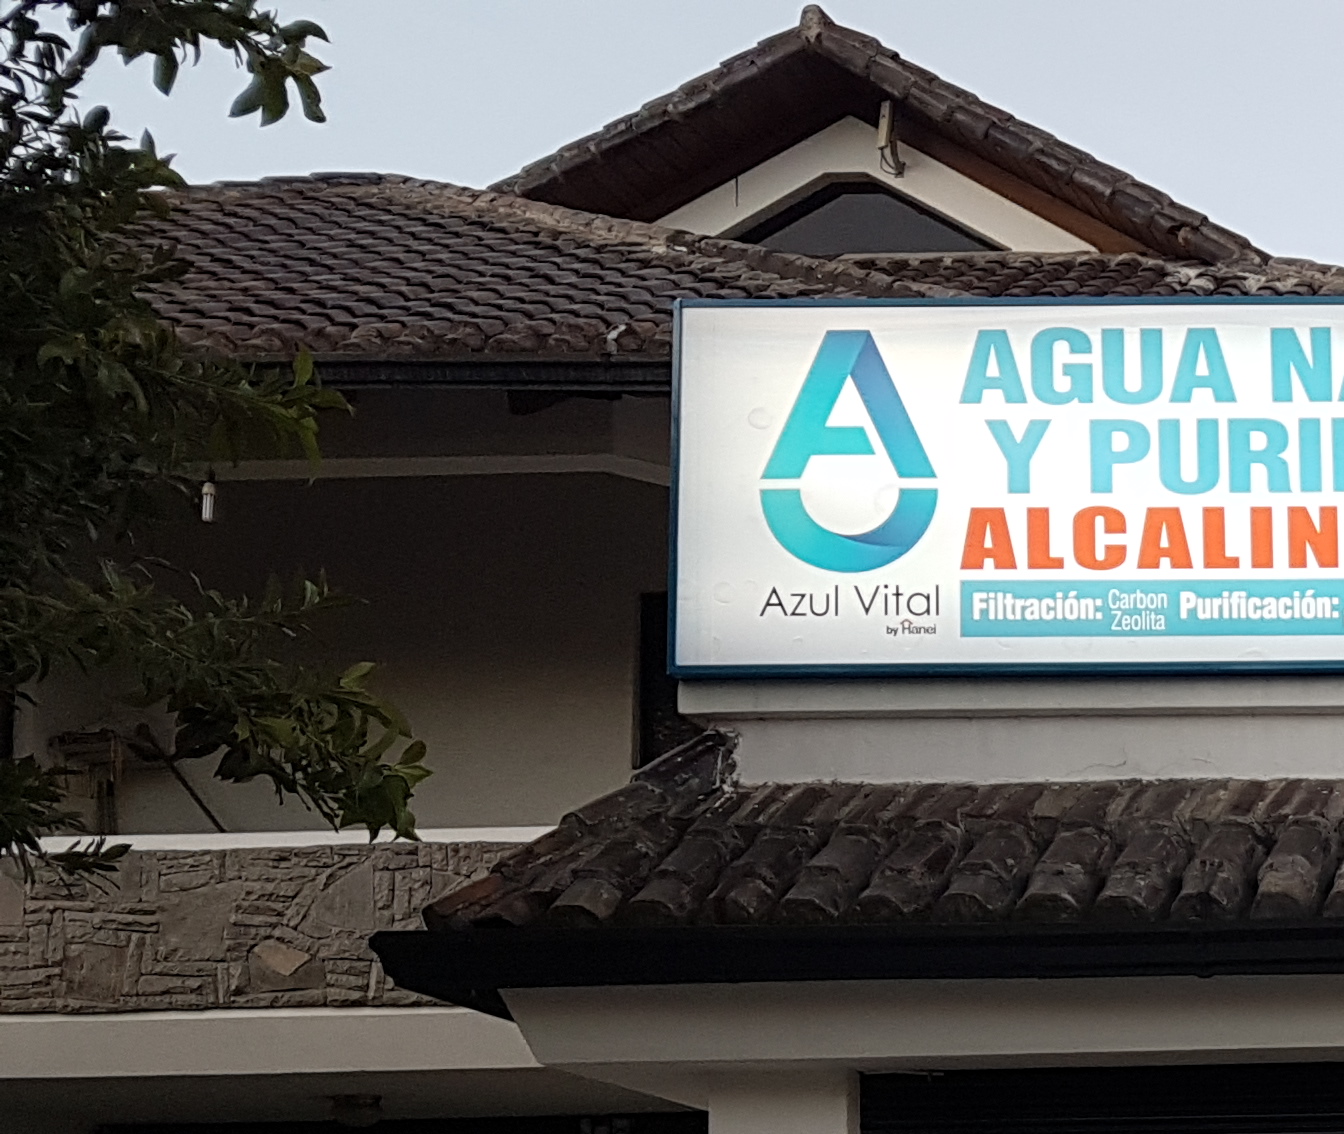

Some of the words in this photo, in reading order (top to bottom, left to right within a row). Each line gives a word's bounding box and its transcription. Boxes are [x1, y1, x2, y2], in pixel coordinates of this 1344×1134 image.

[959, 327, 1237, 404] AGUA
[985, 419, 1052, 494] Y
[760, 585, 839, 617] Azul
[854, 585, 940, 617] Vital
[972, 593, 1103, 620] Filtración:
[1108, 589, 1168, 611] Carbon
[1180, 590, 1340, 620] Purificación:
[886, 625, 898, 636] by
[1110, 610, 1166, 631] Zeolita
